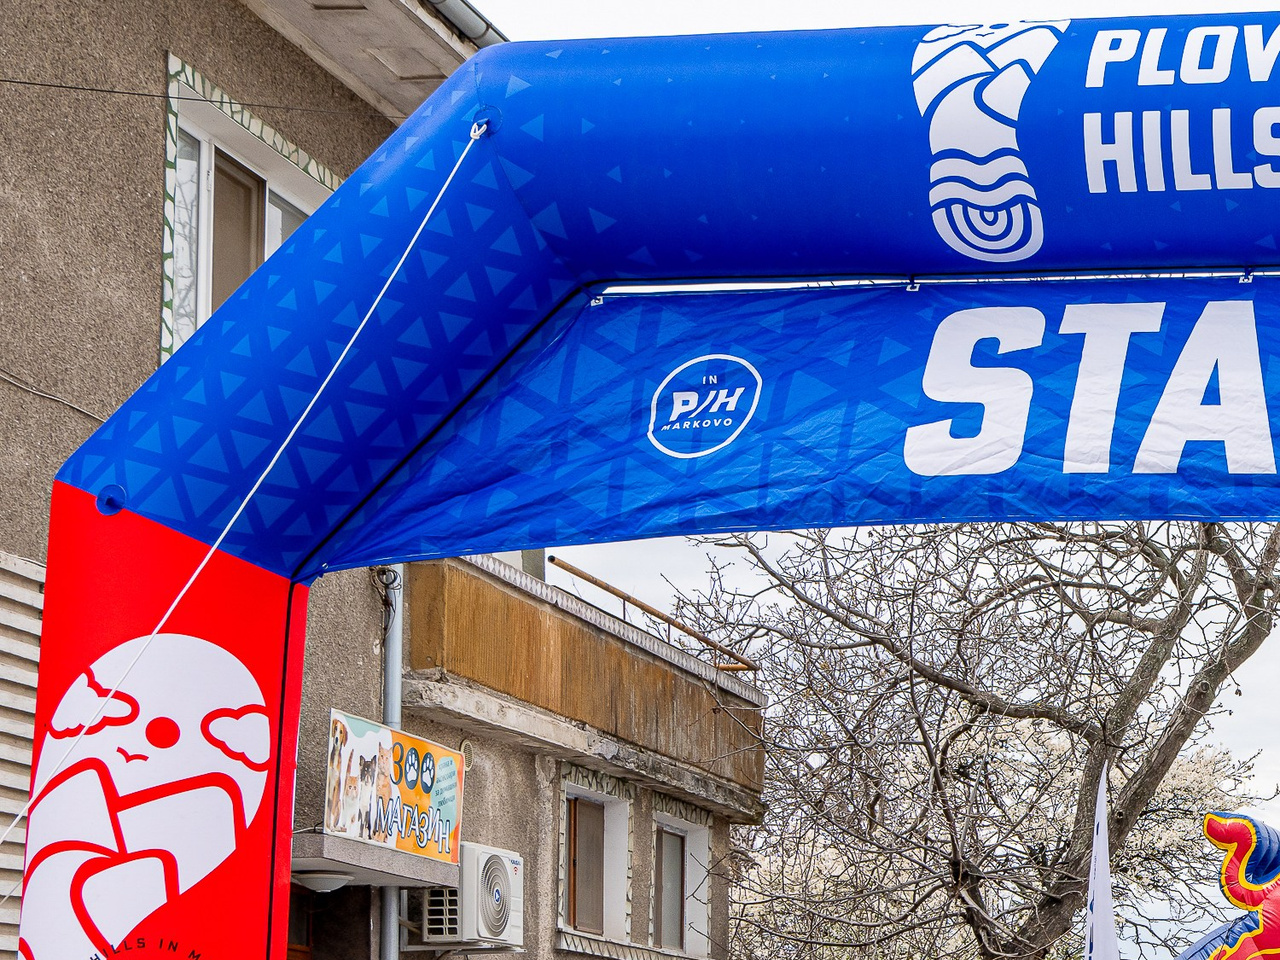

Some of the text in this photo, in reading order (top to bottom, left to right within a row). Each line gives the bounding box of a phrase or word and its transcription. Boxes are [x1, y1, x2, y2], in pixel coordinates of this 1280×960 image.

[702, 375, 718, 385] IN
[668, 387, 746, 422] P/H
[660, 418, 733, 431] MARKOVO
[375, 796, 451, 854] МАГАЗИН
[159, 938, 179, 953] IN
